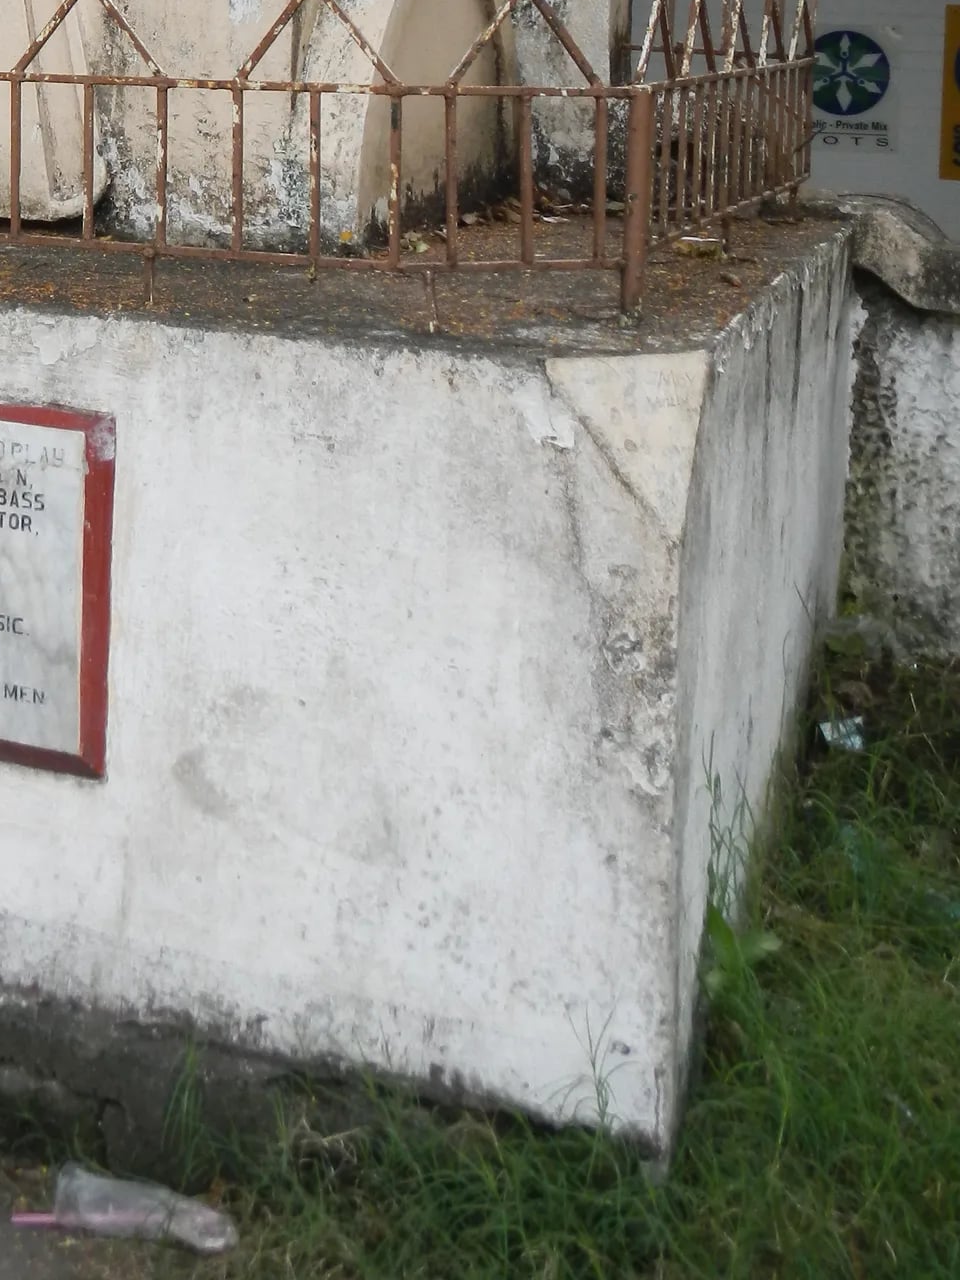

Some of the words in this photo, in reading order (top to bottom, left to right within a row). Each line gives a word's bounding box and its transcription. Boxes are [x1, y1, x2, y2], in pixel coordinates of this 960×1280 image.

[835, 120, 869, 131] Private
[871, 121, 888, 132] Mix
[3, 683, 45, 705] MEN
